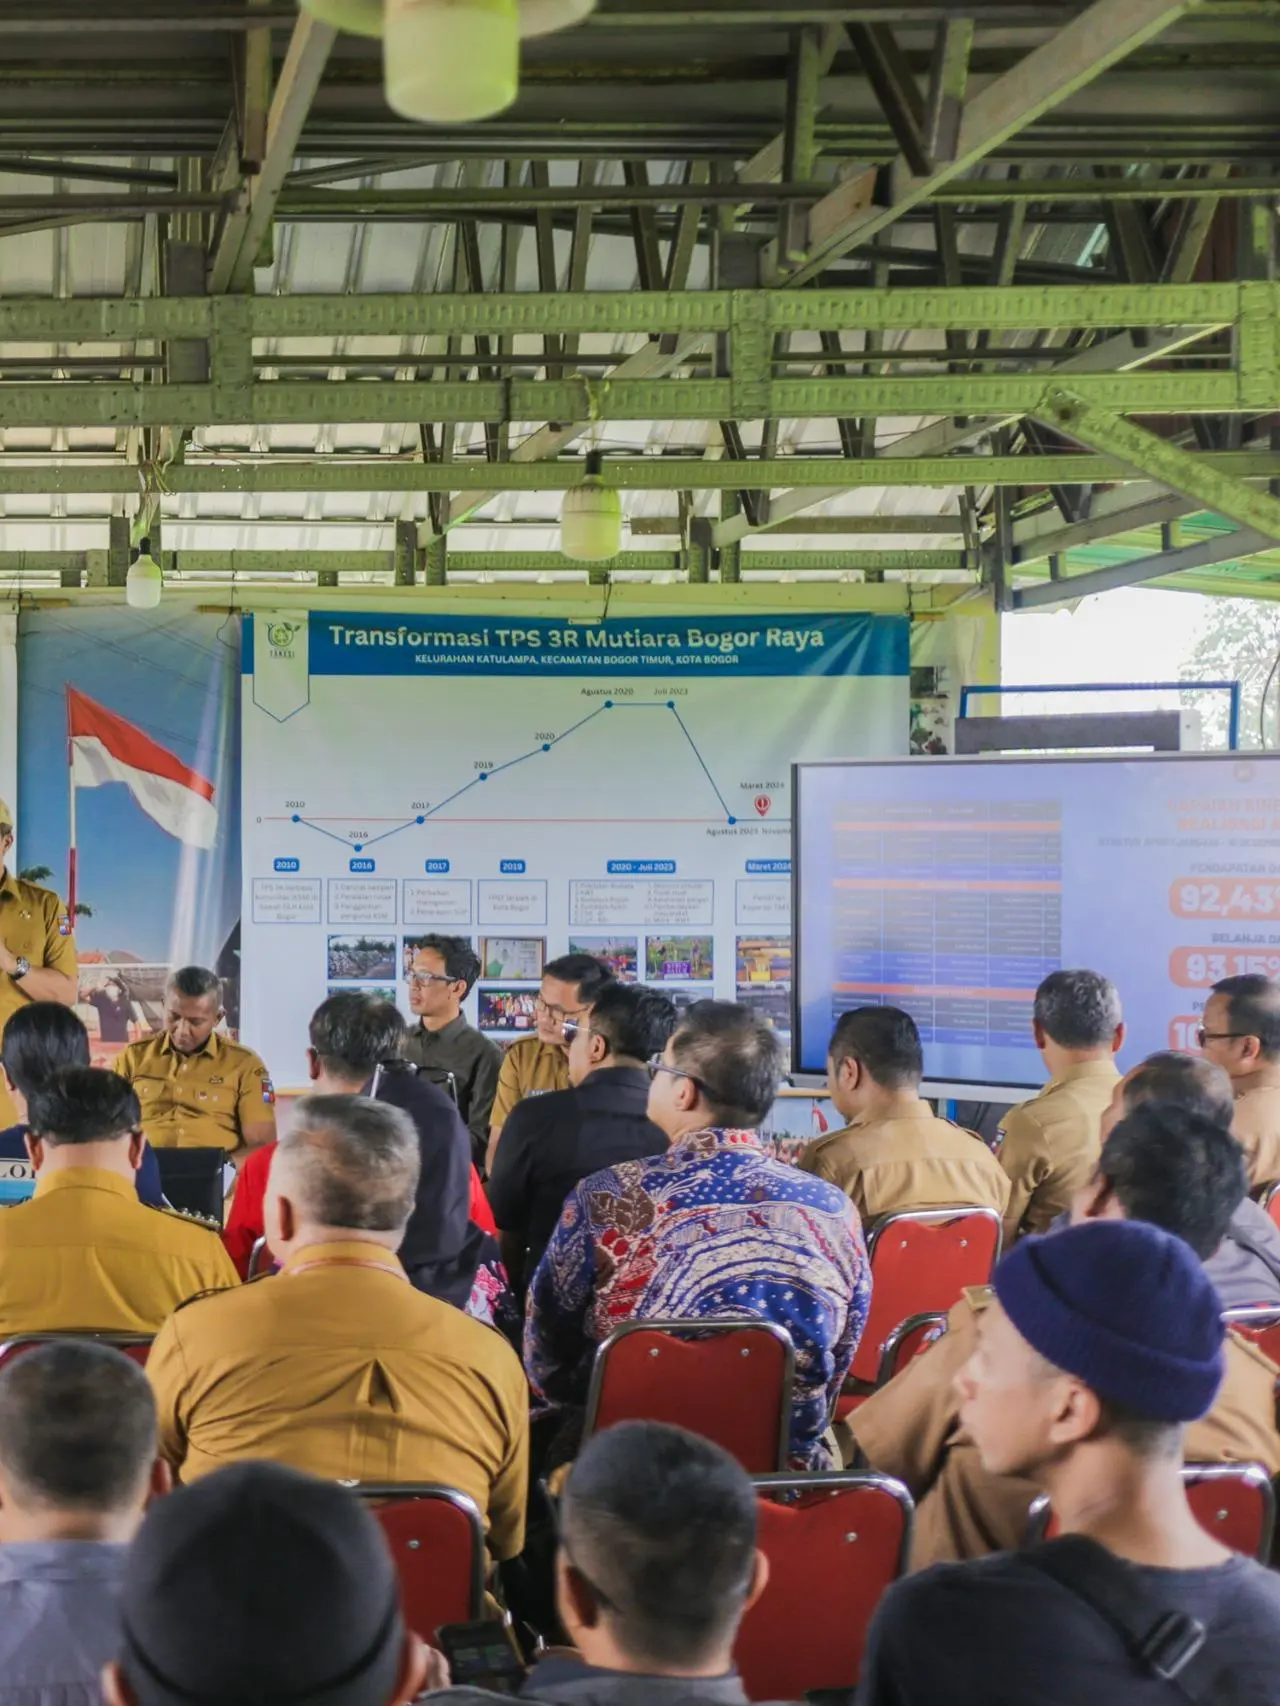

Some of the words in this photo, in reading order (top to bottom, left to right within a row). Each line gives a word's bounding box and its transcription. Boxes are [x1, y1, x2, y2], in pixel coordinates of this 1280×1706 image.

[328, 625, 489, 647] Transformasi
[495, 629, 541, 648] TPS
[548, 629, 579, 648] 3R
[586, 629, 681, 648] Mutiara
[687, 628, 760, 652] Bogor
[766, 627, 825, 652] Raya
[415, 654, 474, 664] KELURAHAN
[476, 654, 539, 665] KATULAMPA,
[541, 655, 601, 665] KECAMATAN
[603, 655, 638, 665] BOGOR
[641, 655, 674, 665] TIMUR,
[676, 655, 702, 665] KOTA
[704, 655, 739, 665] BOGOR
[580, 687, 612, 697] Agustus
[614, 687, 634, 696] 2020
[653, 687, 668, 696] Juli
[534, 732, 555, 741] 2020
[473, 761, 494, 769] 2019
[740, 782, 763, 790] Maret
[348, 831, 369, 839] 2016
[706, 828, 738, 837] Agustus
[276, 861, 297, 869] 2010
[427, 862, 447, 870] 2017
[611, 863, 632, 871] 2020
[638, 863, 652, 871] Juli
[748, 862, 771, 871] Maret
